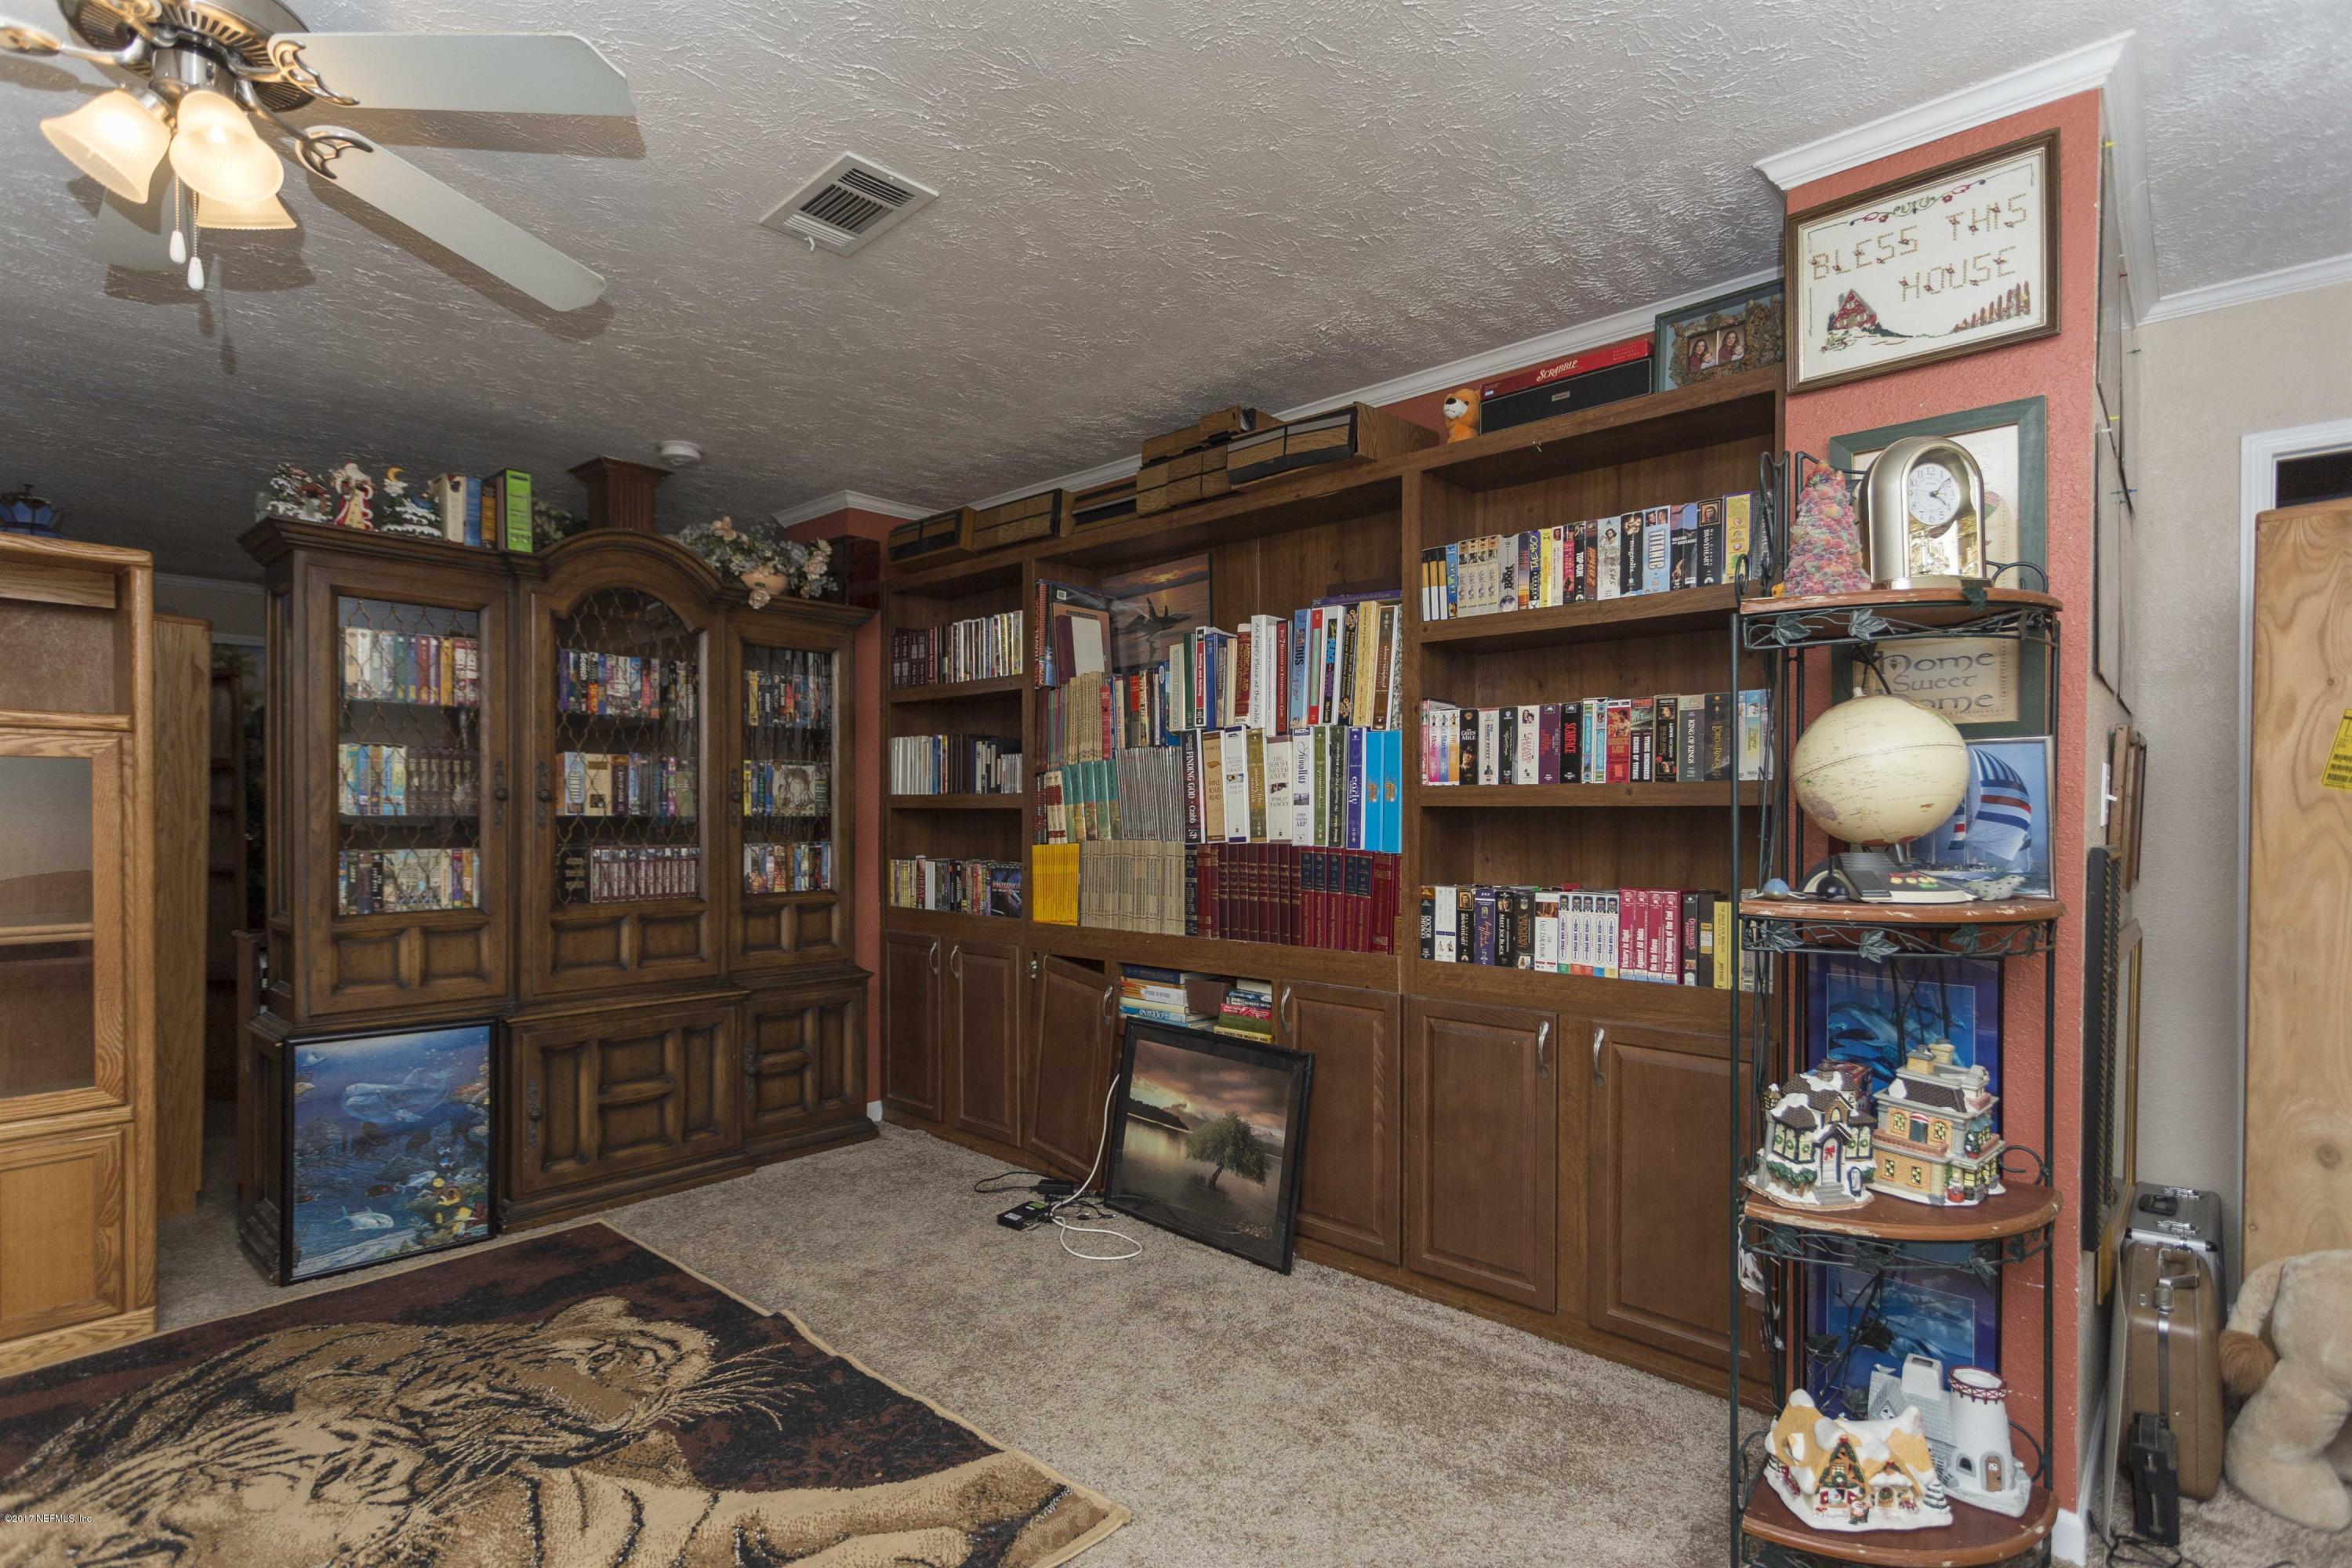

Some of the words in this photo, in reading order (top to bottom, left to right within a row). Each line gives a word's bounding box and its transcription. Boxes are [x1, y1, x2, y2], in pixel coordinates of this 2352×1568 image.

[1810, 226, 1918, 281] BLESS
[1945, 194, 2027, 241] THIS
[1899, 246, 2016, 301] HOUSE
[1536, 359, 1579, 382] SCRABBLE
[1926, 466, 1935, 475] 12
[1649, 529, 1665, 570] TITANIC
[1504, 563, 1514, 590] Boot
[1254, 623, 1260, 633] An
[1327, 637, 1336, 664] PEACE
[1876, 650, 1994, 674] Home
[1893, 674, 1979, 692] Sweet
[1564, 723, 1576, 753] SCARFACE
[1186, 751, 1195, 781] FINDING
[1712, 746, 1722, 769] RINGS
[1298, 770, 1308, 786] HALF
[1349, 776, 1359, 804] early
